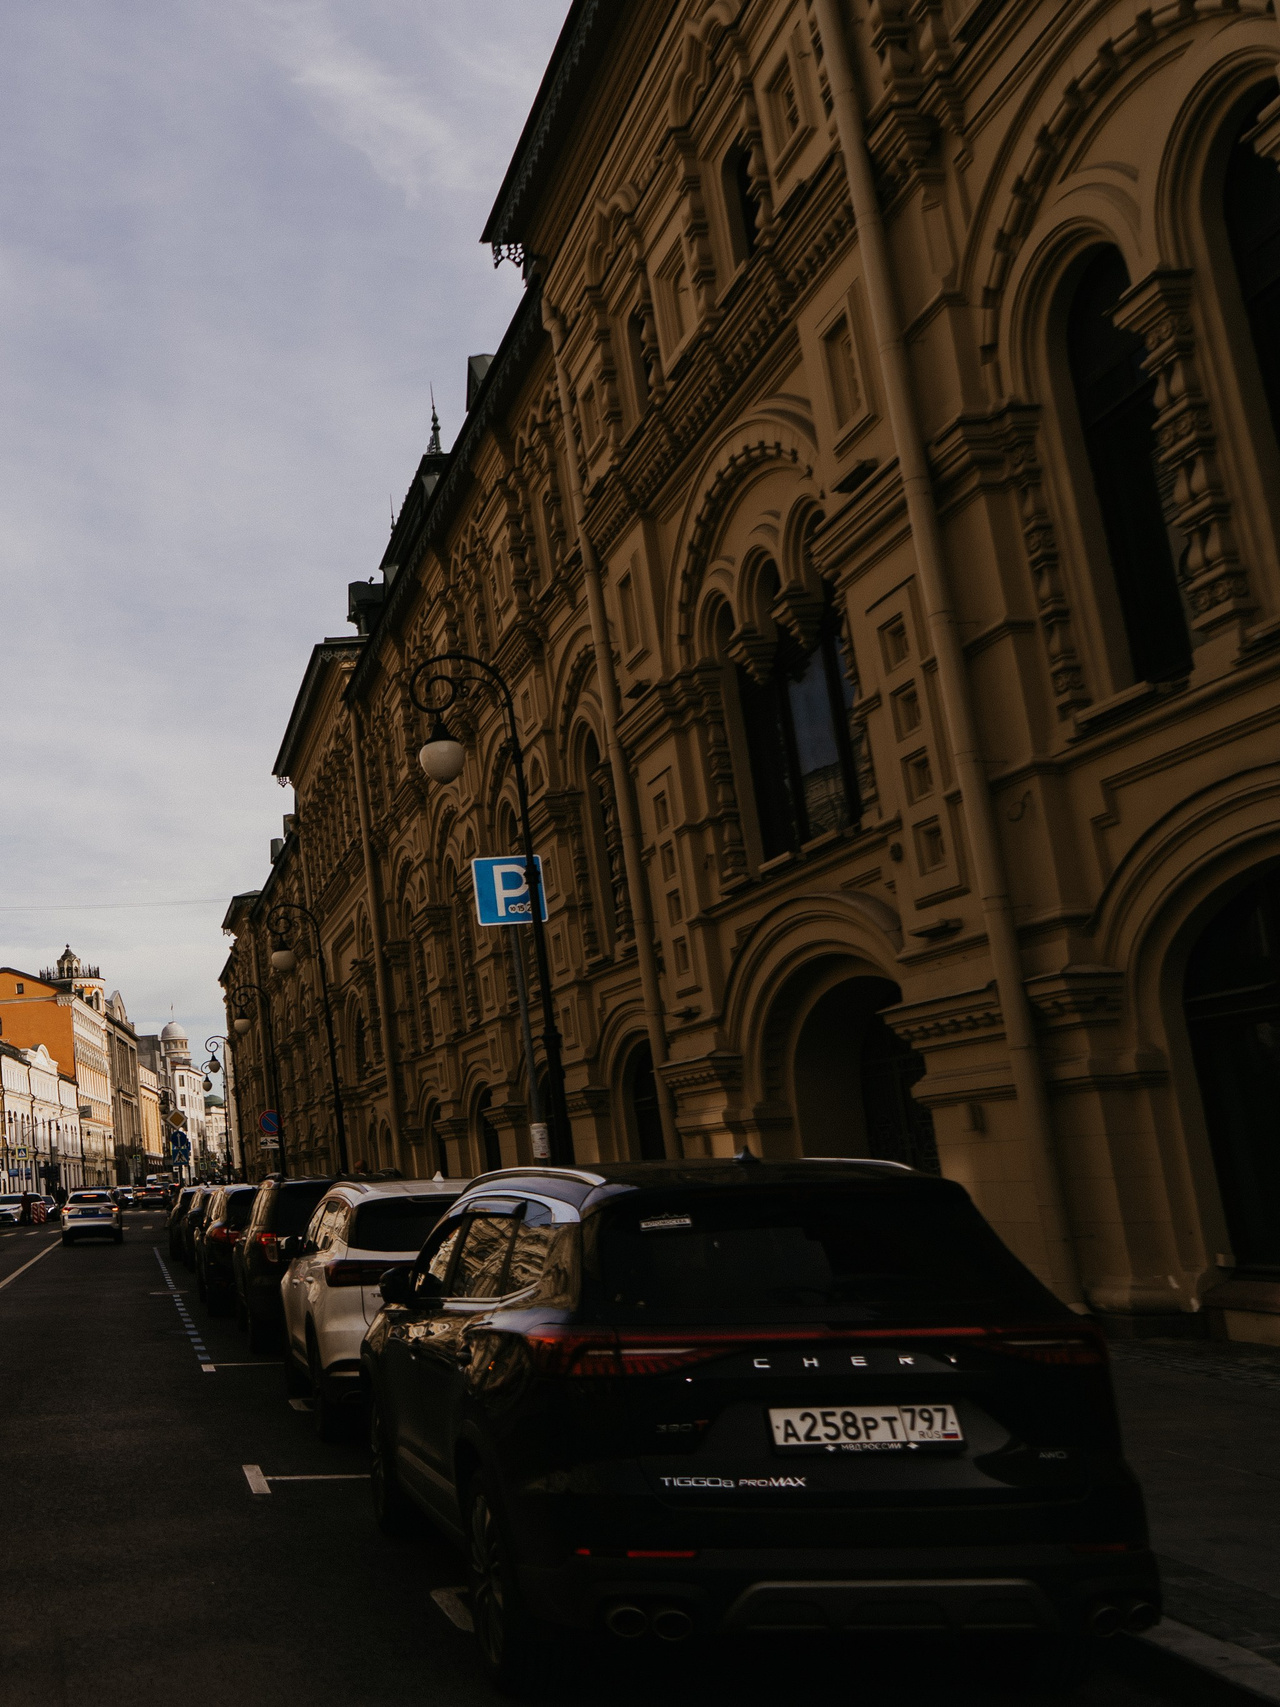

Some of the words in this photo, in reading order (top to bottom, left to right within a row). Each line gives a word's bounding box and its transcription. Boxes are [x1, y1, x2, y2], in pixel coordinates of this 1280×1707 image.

[492, 864, 529, 917] P
[517, 904, 525, 912] 15
[753, 1353, 958, 1368] CHERY
[783, 1410, 898, 1443] А258РТ
[901, 1407, 949, 1431] 797
[919, 1430, 941, 1439] RUS
[841, 1443, 862, 1452] МВД
[862, 1442, 903, 1451] РОССИИ
